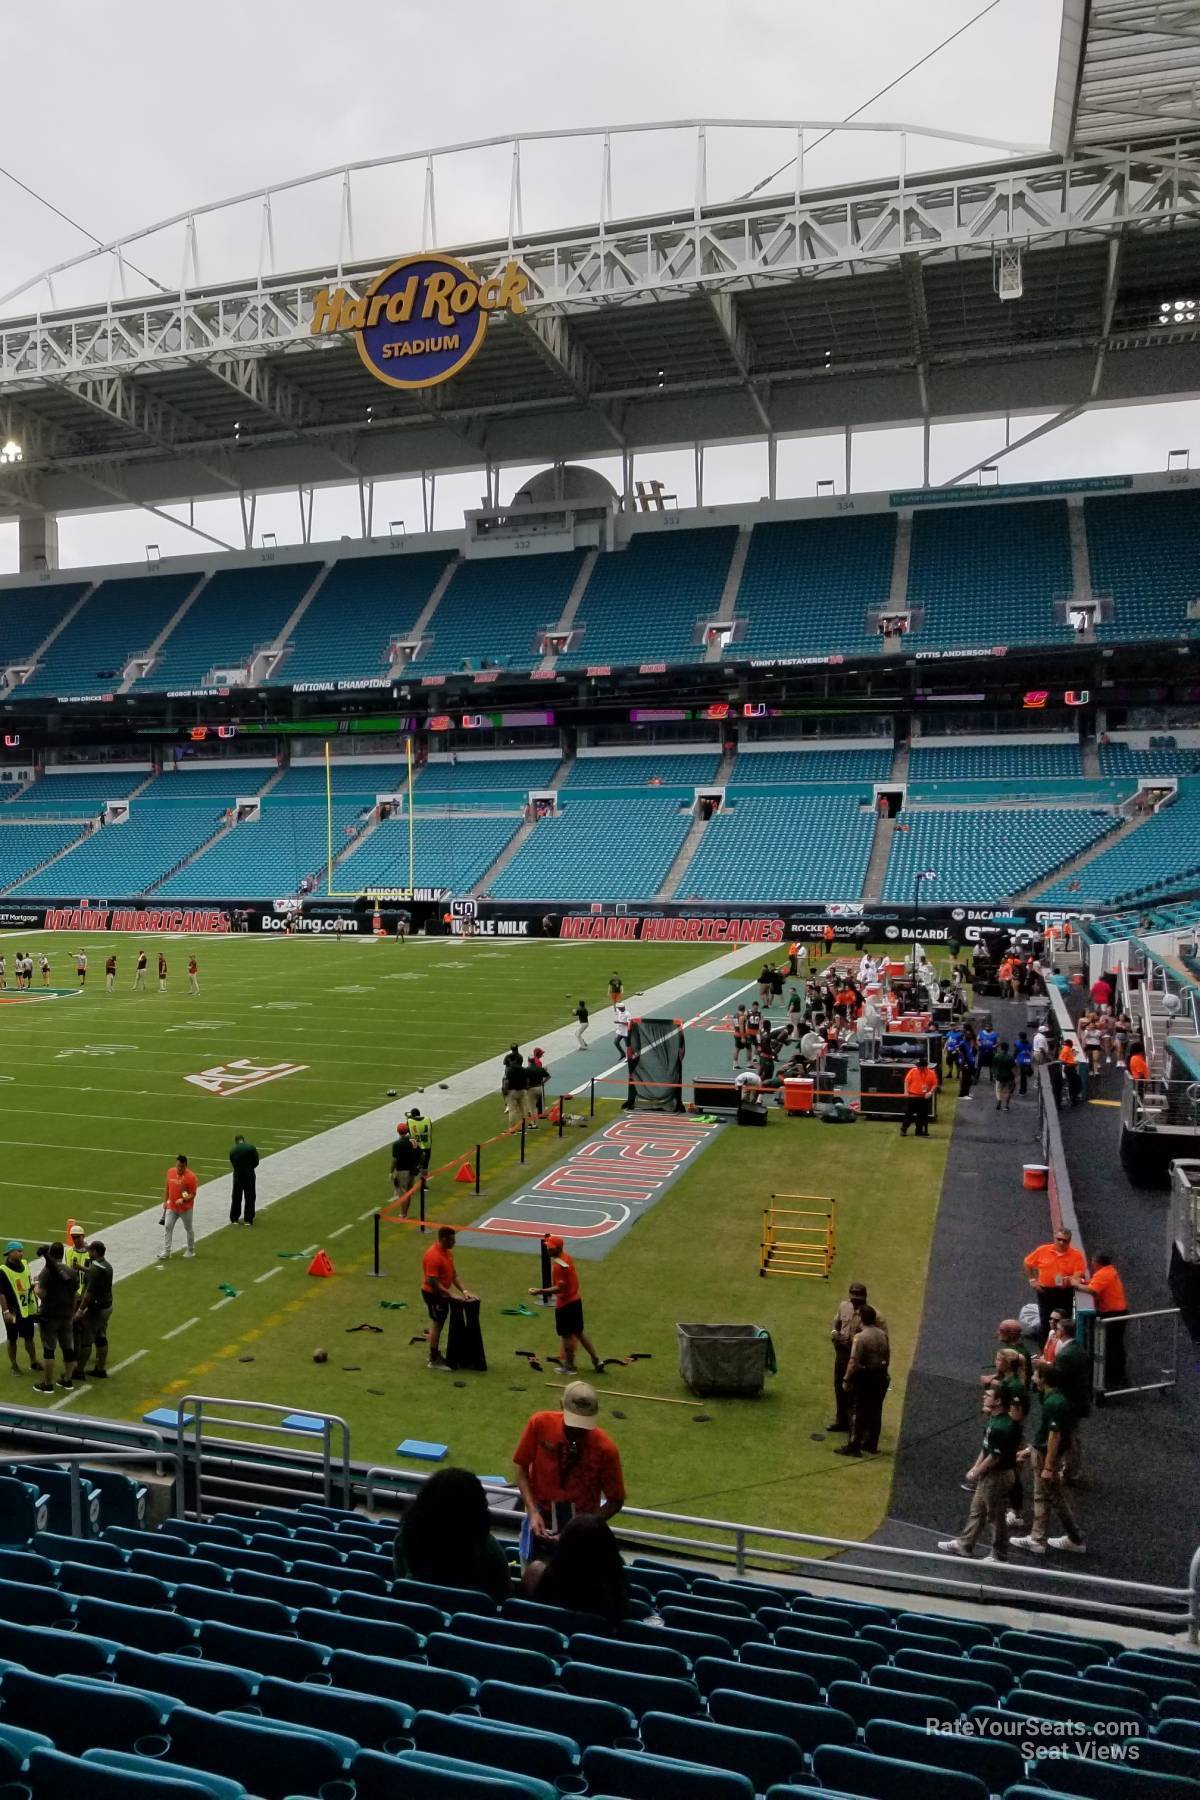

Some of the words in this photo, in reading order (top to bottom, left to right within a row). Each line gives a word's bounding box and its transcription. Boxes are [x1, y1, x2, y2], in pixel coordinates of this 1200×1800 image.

[311, 275, 419, 334] Hard
[422, 260, 529, 326] Rock
[382, 334, 460, 358] STADIUM
[915, 651, 941, 659] OTTIS
[942, 648, 992, 658] ANDERSON
[750, 659, 776, 667] VINNY
[777, 657, 829, 666] TESTAVERDE
[292, 682, 335, 693] NATIONAL
[337, 679, 392, 690] CHAMPIONS
[366, 888, 411, 901] MUSCLE
[413, 888, 442, 901] MILK
[455, 902, 473, 915] 40
[9, 914, 39, 924] Mortgage
[43, 909, 111, 930] MIAMI
[111, 910, 228, 933] HURRICANES
[451, 919, 495, 935] MUCLE
[497, 920, 528, 935] MILK
[559, 916, 639, 939] MIAMI
[640, 917, 786, 942] HURRICANES
[791, 924, 830, 932] ROCKET
[901, 926, 949, 941] BACARDÍ
[183, 1058, 295, 1094] ACC
